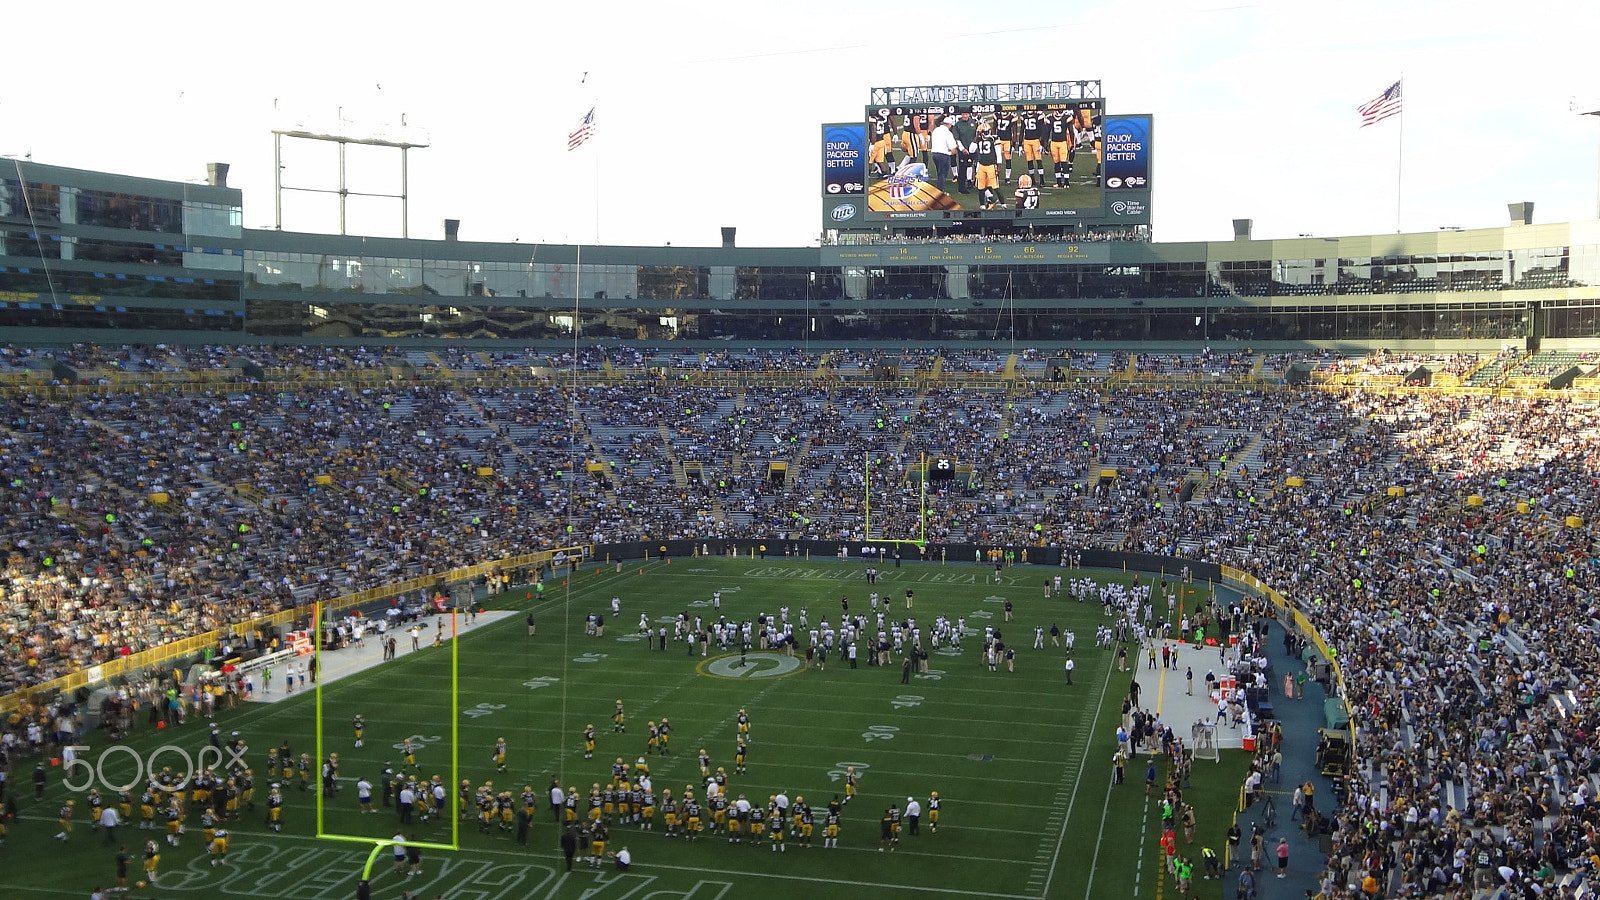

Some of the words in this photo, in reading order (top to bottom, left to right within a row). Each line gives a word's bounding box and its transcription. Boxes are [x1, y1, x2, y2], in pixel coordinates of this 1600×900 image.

[900, 85, 998, 102] LAMBEAU
[1009, 82, 1071, 99] FIELD
[1024, 118, 1036, 130] 16
[1053, 120, 1062, 133] 5
[1106, 134, 1132, 143] ENJOY
[826, 142, 850, 150] ENJOY
[978, 140, 991, 155] 13
[1106, 143, 1142, 152] PACKERS
[826, 151, 859, 159] PACKERS
[1106, 152, 1136, 161] BETTER
[826, 159, 854, 168] BETTER
[983, 246, 993, 254] 15
[937, 459, 950, 469] 25
